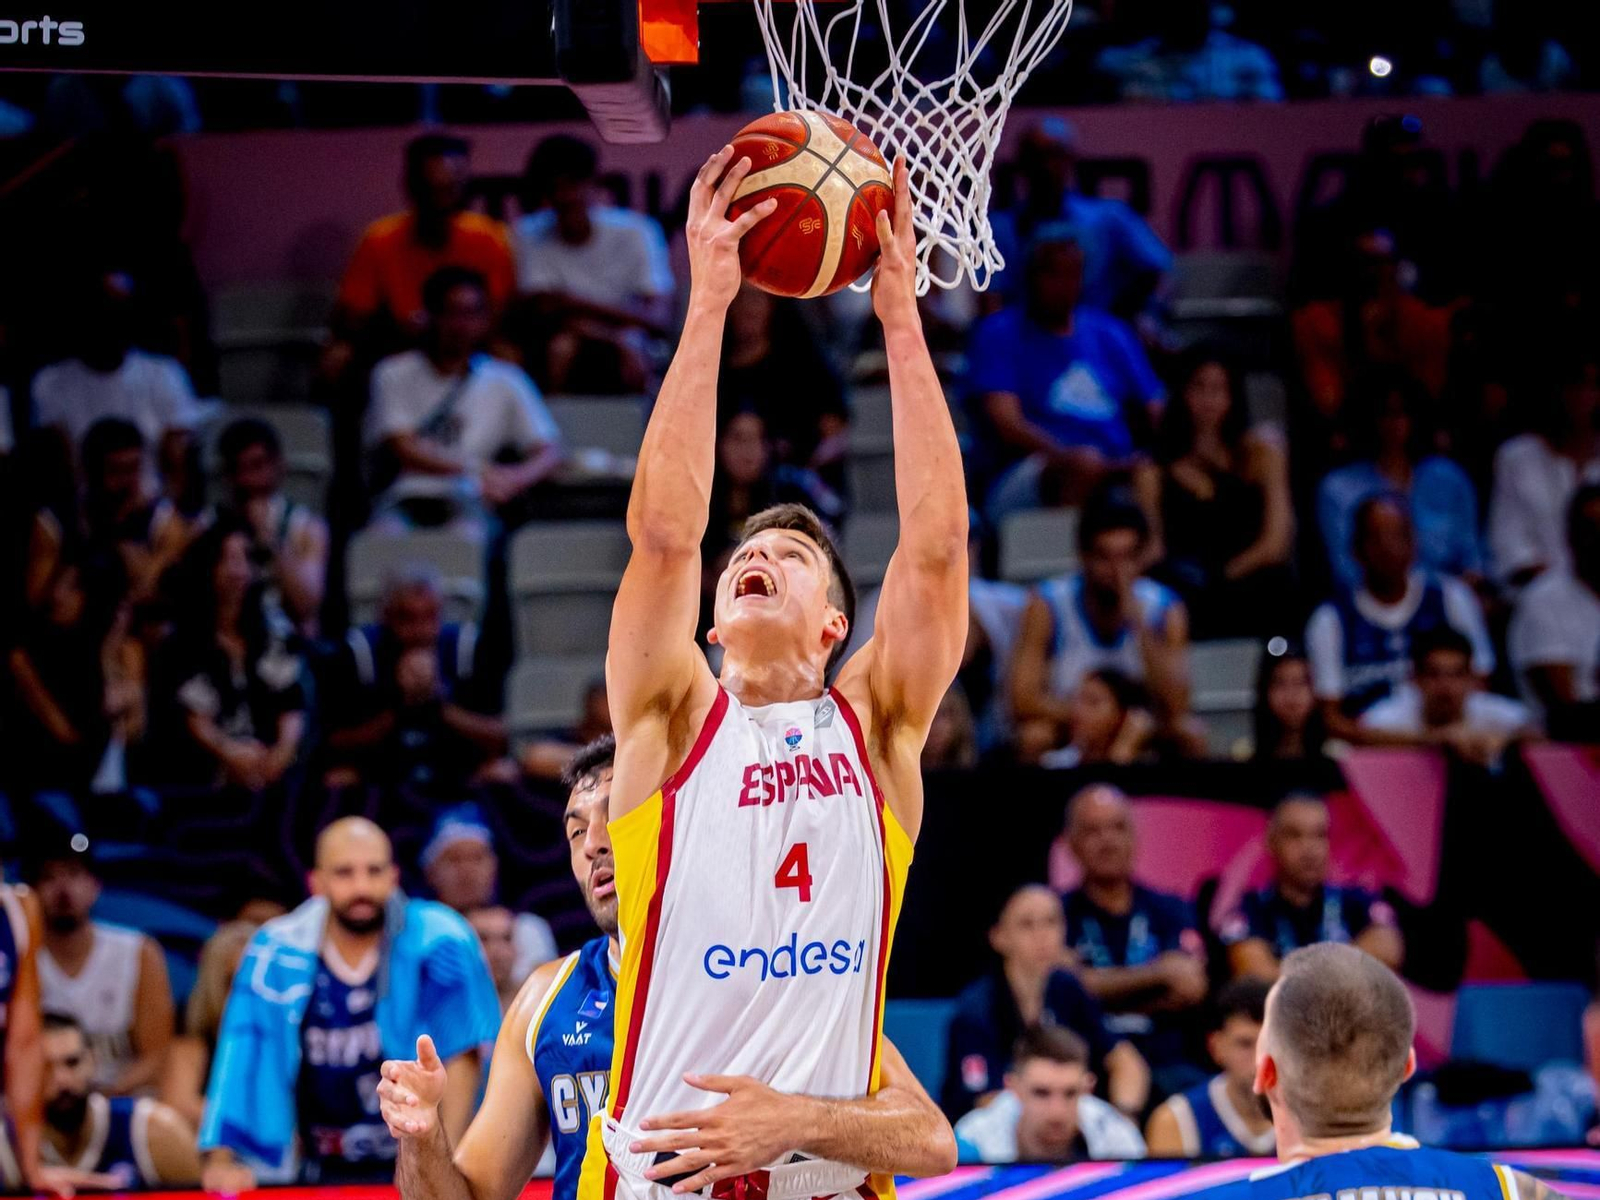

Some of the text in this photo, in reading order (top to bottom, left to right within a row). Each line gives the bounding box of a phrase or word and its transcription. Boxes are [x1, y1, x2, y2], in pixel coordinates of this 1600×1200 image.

[0, 15, 85, 46] orts
[774, 842, 813, 903] 4
[562, 1033, 592, 1047] VAAT
[551, 1070, 611, 1134] CY
